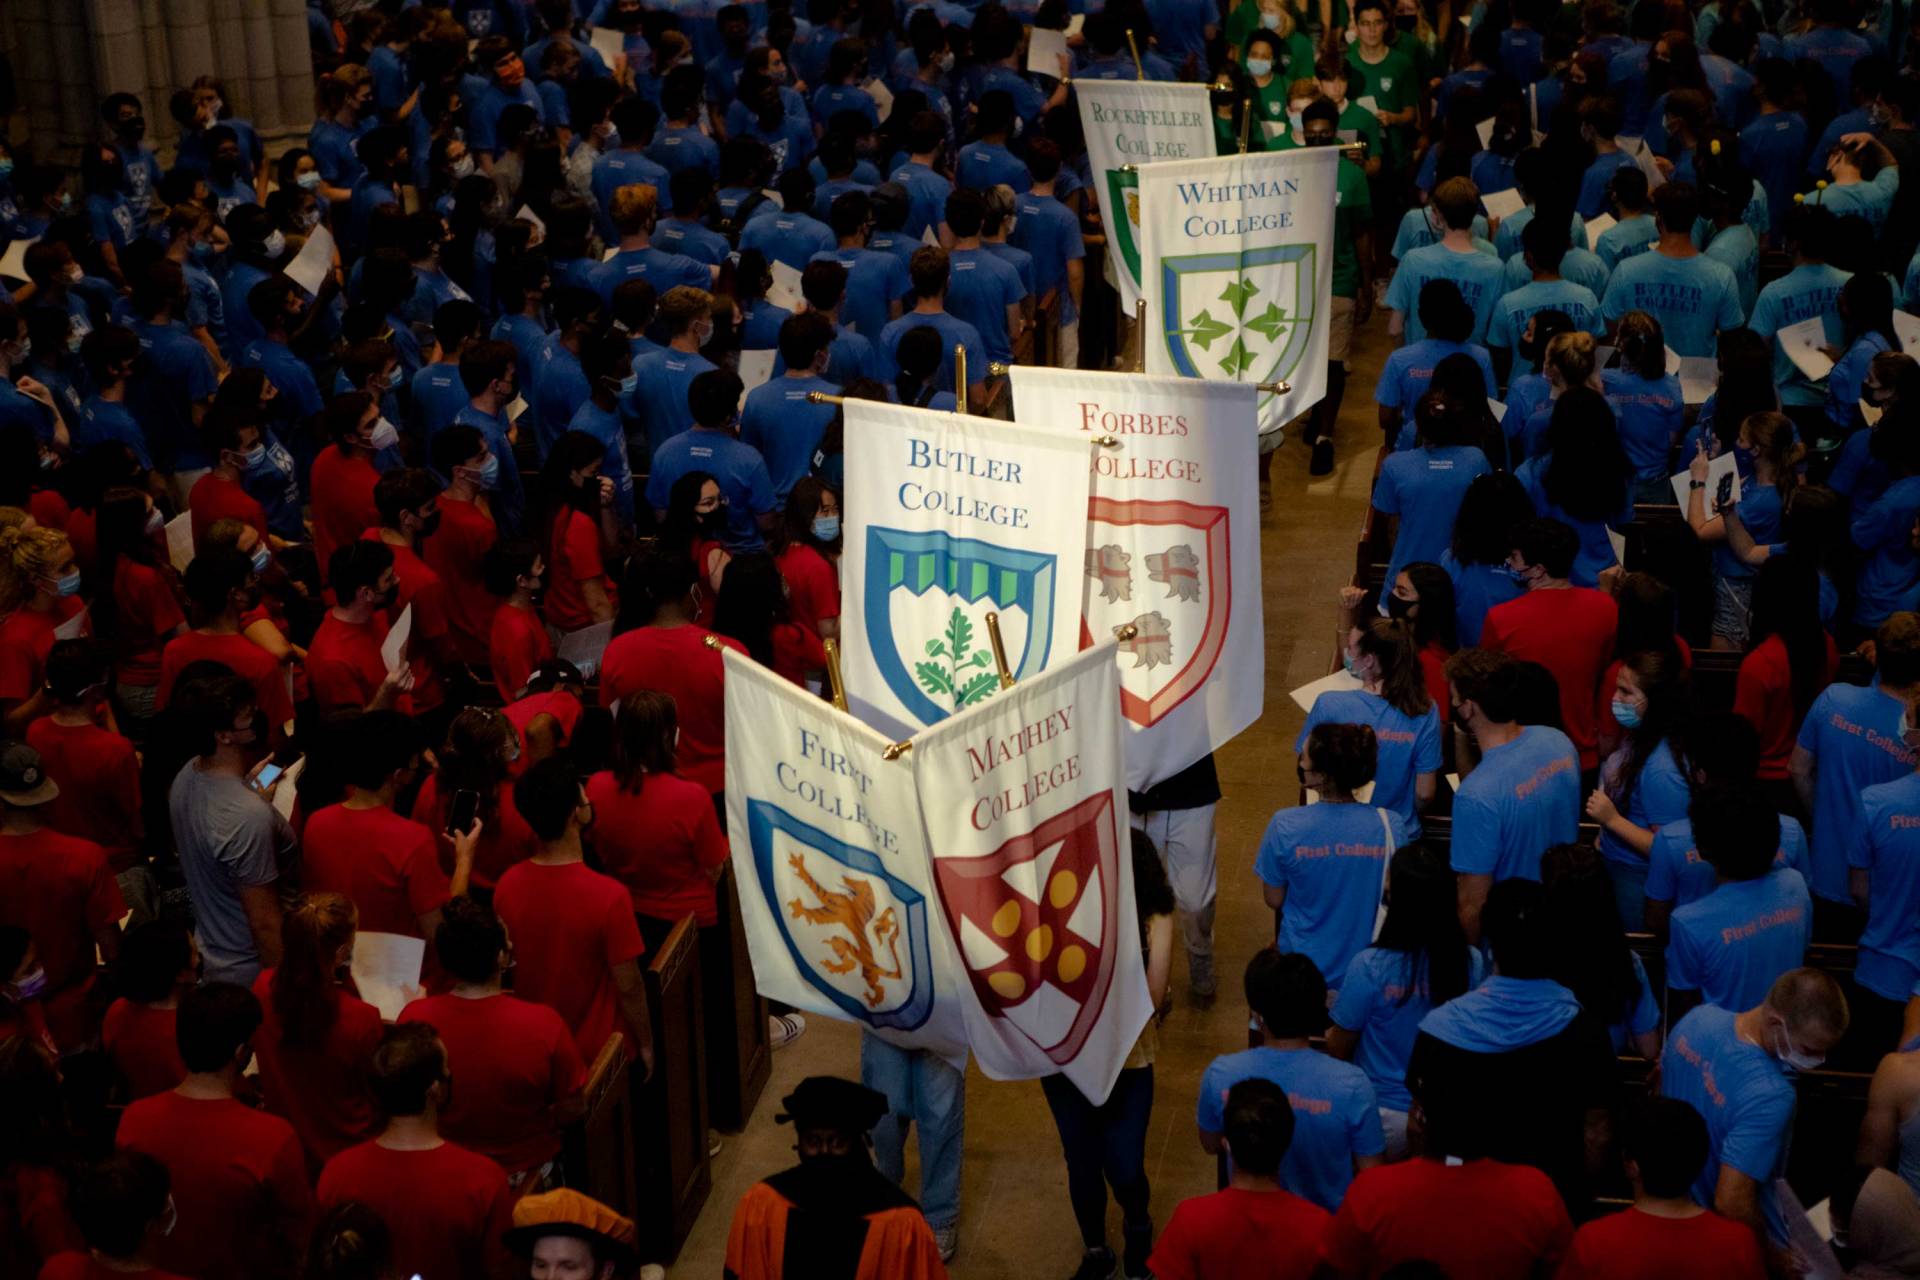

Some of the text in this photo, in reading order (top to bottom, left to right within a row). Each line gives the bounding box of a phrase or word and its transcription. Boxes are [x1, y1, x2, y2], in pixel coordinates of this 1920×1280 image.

[1177, 178, 1300, 205] WHITMAN
[1184, 212, 1293, 238] COLLEGE
[1077, 402, 1189, 437] FORBES
[907, 439, 1022, 484] BUTLER
[1090, 455, 1202, 484] OLLEGE
[898, 482, 1030, 529] COLLEGE
[966, 705, 1073, 782] MATHEY
[971, 755, 1082, 832] COLLEGE
